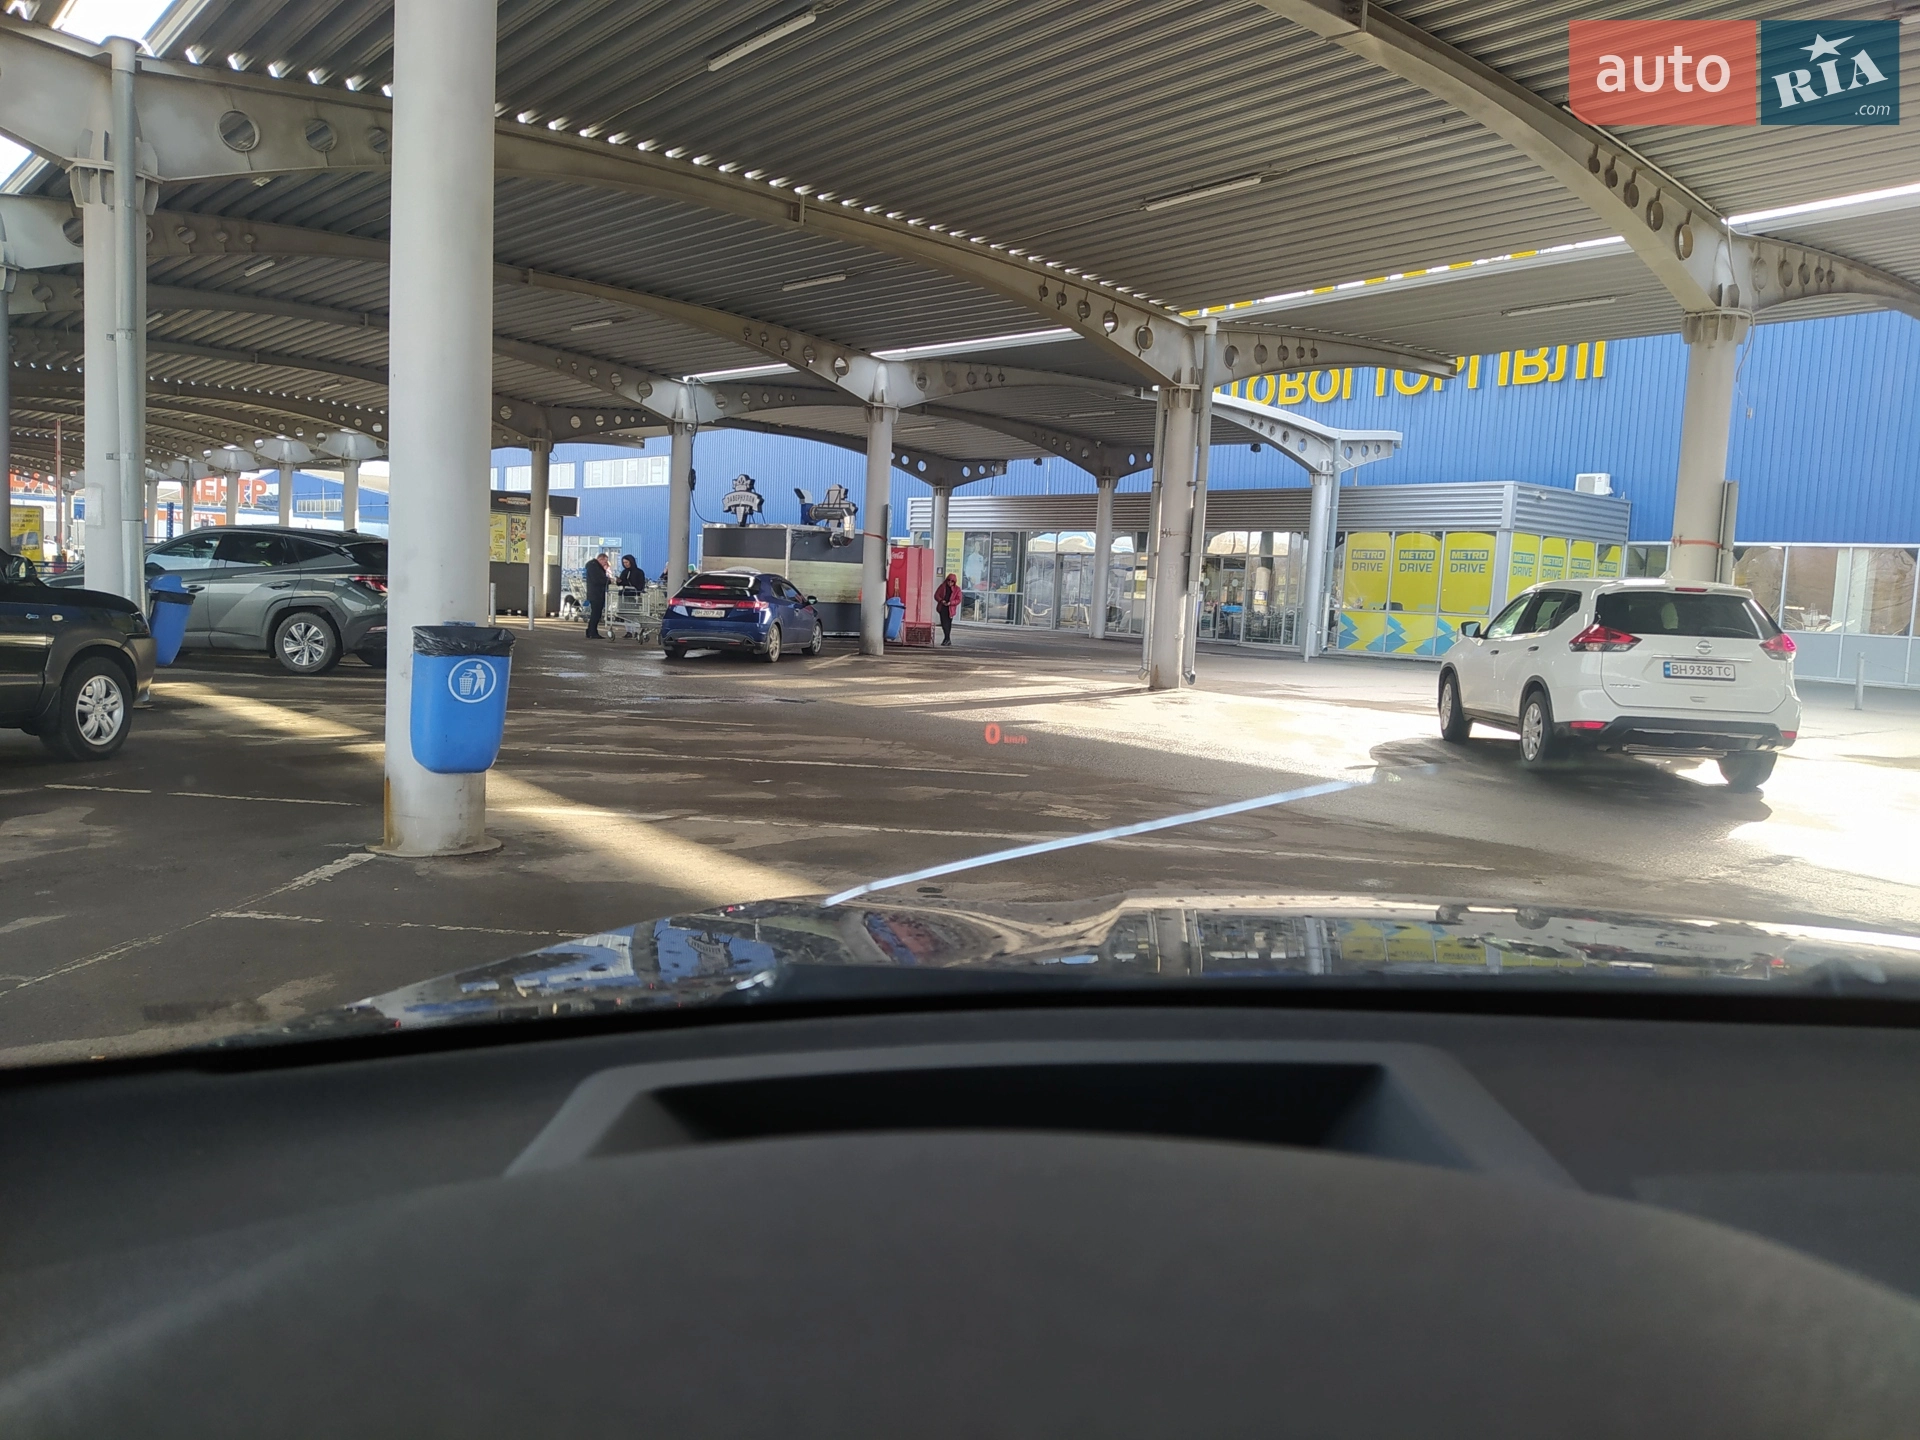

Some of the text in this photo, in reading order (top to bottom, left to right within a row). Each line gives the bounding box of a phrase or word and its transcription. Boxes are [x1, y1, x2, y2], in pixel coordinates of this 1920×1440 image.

[1352, 550, 1385, 560] METRO
[1399, 550, 1435, 560] METRO
[1450, 550, 1488, 560] METRO
[1513, 553, 1535, 564] METRO
[1543, 555, 1563, 567] METRO
[1571, 558, 1591, 570] METRO
[1351, 562, 1383, 572] DRIVE
[1399, 563, 1433, 573] DRIVE
[1450, 563, 1486, 574] DRIVE
[1512, 566, 1533, 577] DRIVE
[1542, 568, 1562, 579] DRIVE
[1671, 664, 1731, 677] BH 9338 TC
[984, 721, 1001, 745] 0
